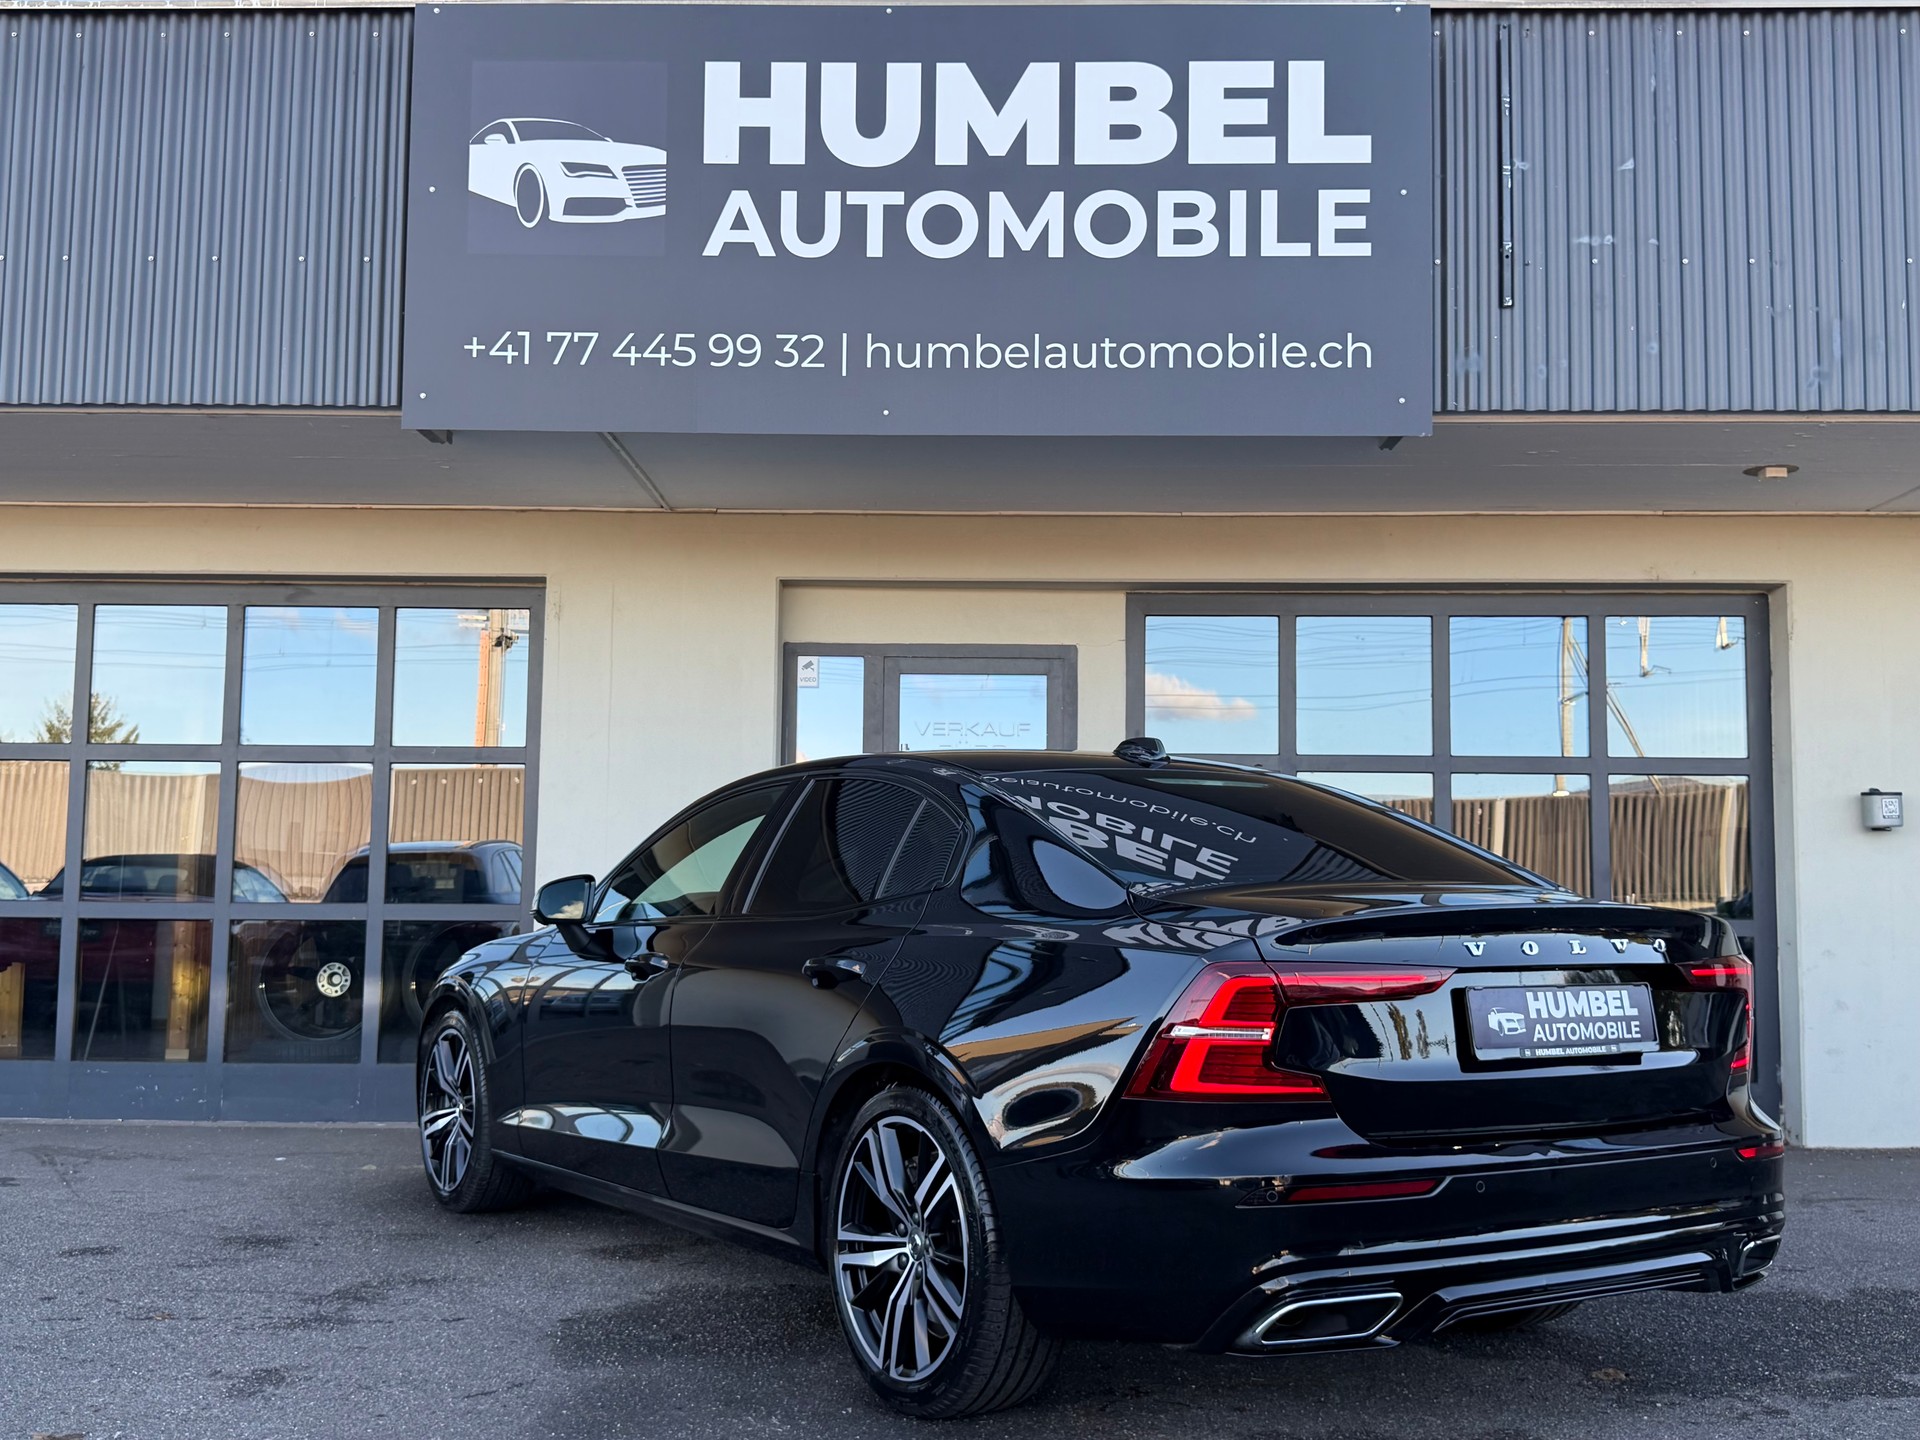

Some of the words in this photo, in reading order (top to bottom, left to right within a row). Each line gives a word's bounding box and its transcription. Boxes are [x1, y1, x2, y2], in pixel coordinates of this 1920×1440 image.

[703, 60, 1372, 168] HUMBEL
[702, 189, 1372, 259] AUTOMOBILE
[463, 330, 531, 365] +41
[546, 331, 599, 366] 77
[612, 332, 697, 367] 445
[708, 333, 762, 368] 99
[774, 333, 825, 368] 32
[866, 332, 1372, 369] humbelautomobile.ch
[914, 721, 1032, 738] VERKAUF
[1463, 938, 1667, 957] VOLVO
[1525, 989, 1639, 1020] HUMBEL
[1532, 1020, 1642, 1043] AUTOMOBILE
[1535, 1048, 1565, 1056] HUMBEL
[1566, 1045, 1607, 1055] AUTOMOBILE
